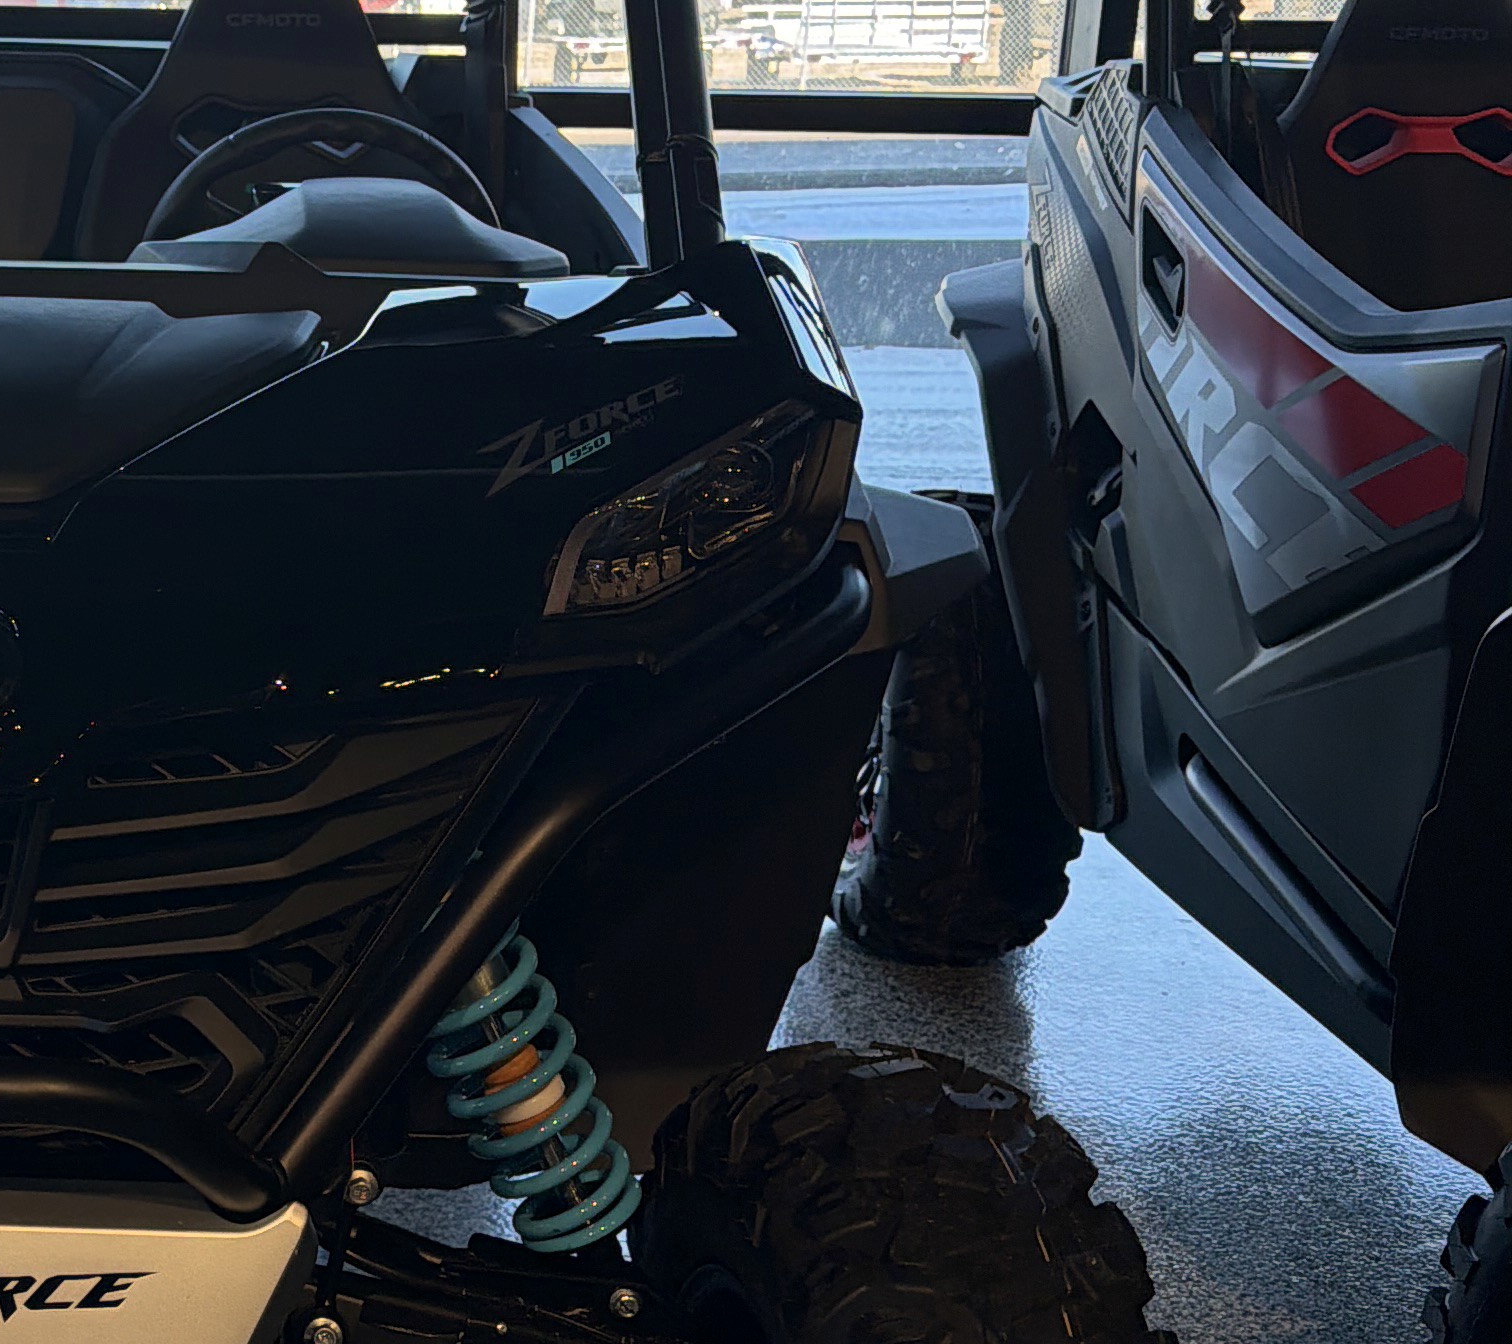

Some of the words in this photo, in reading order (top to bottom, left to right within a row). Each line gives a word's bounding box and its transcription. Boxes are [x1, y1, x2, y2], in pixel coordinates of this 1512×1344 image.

[226, 13, 320, 27] CFMOTO
[476, 375, 685, 498] ZFORCE
[568, 435, 606, 461] 950
